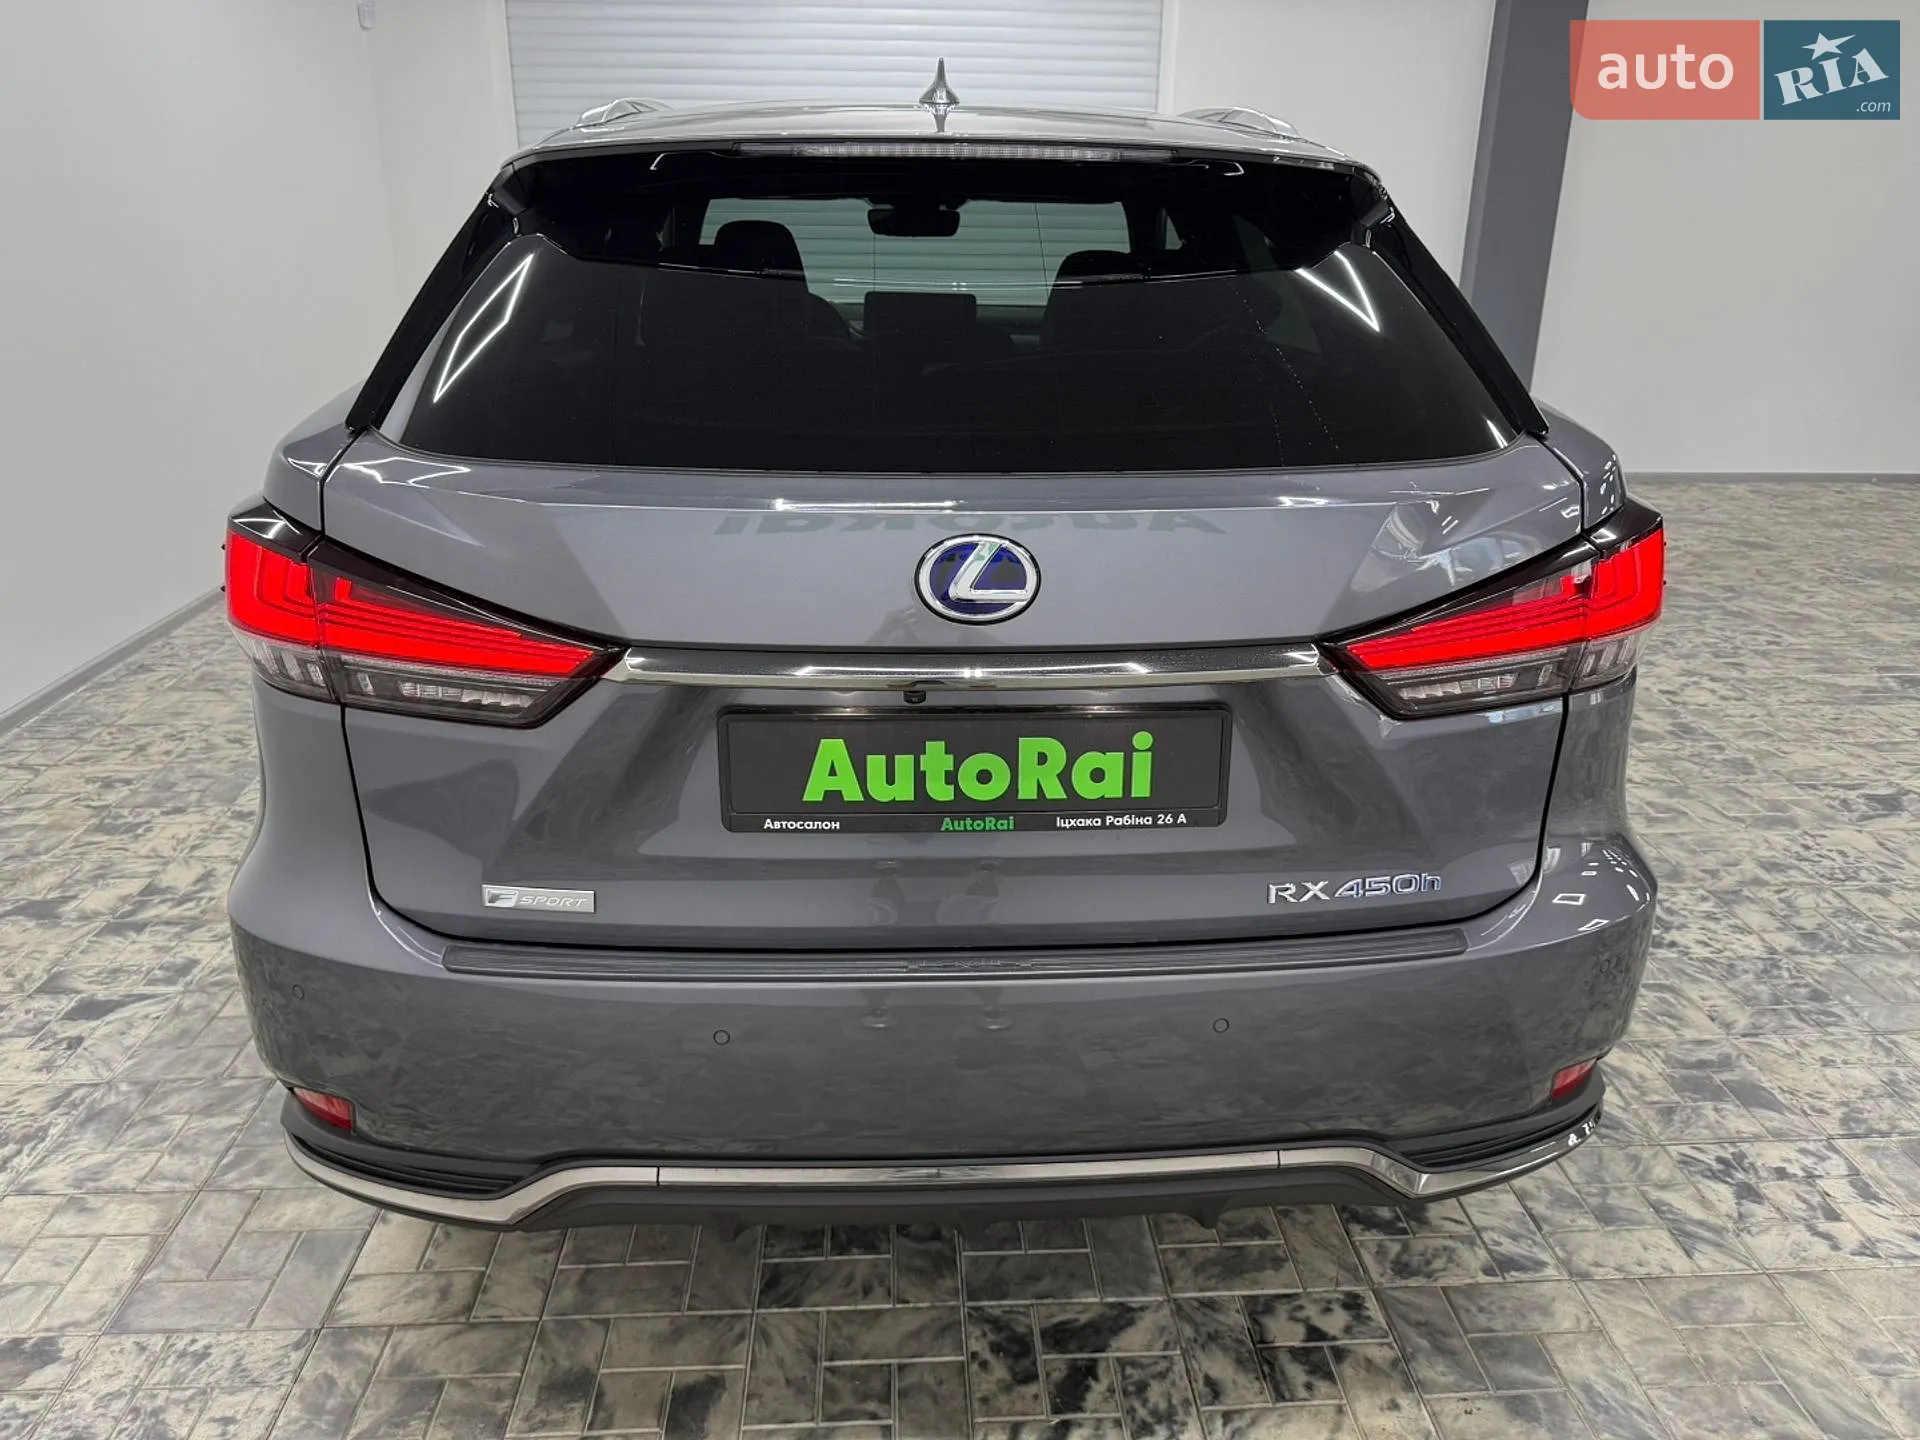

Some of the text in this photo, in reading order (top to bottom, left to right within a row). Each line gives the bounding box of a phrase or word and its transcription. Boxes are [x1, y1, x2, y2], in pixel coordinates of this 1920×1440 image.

[802, 730, 1154, 803] AutoRai
[763, 818, 840, 830] Автосалон
[940, 816, 1015, 831] AutoRai
[1056, 816, 1101, 829] Іцхака
[1105, 814, 1152, 826] Рабіна
[1157, 814, 1173, 825] 26
[1268, 873, 1442, 904] RX 450h
[520, 895, 588, 907] SPORT
